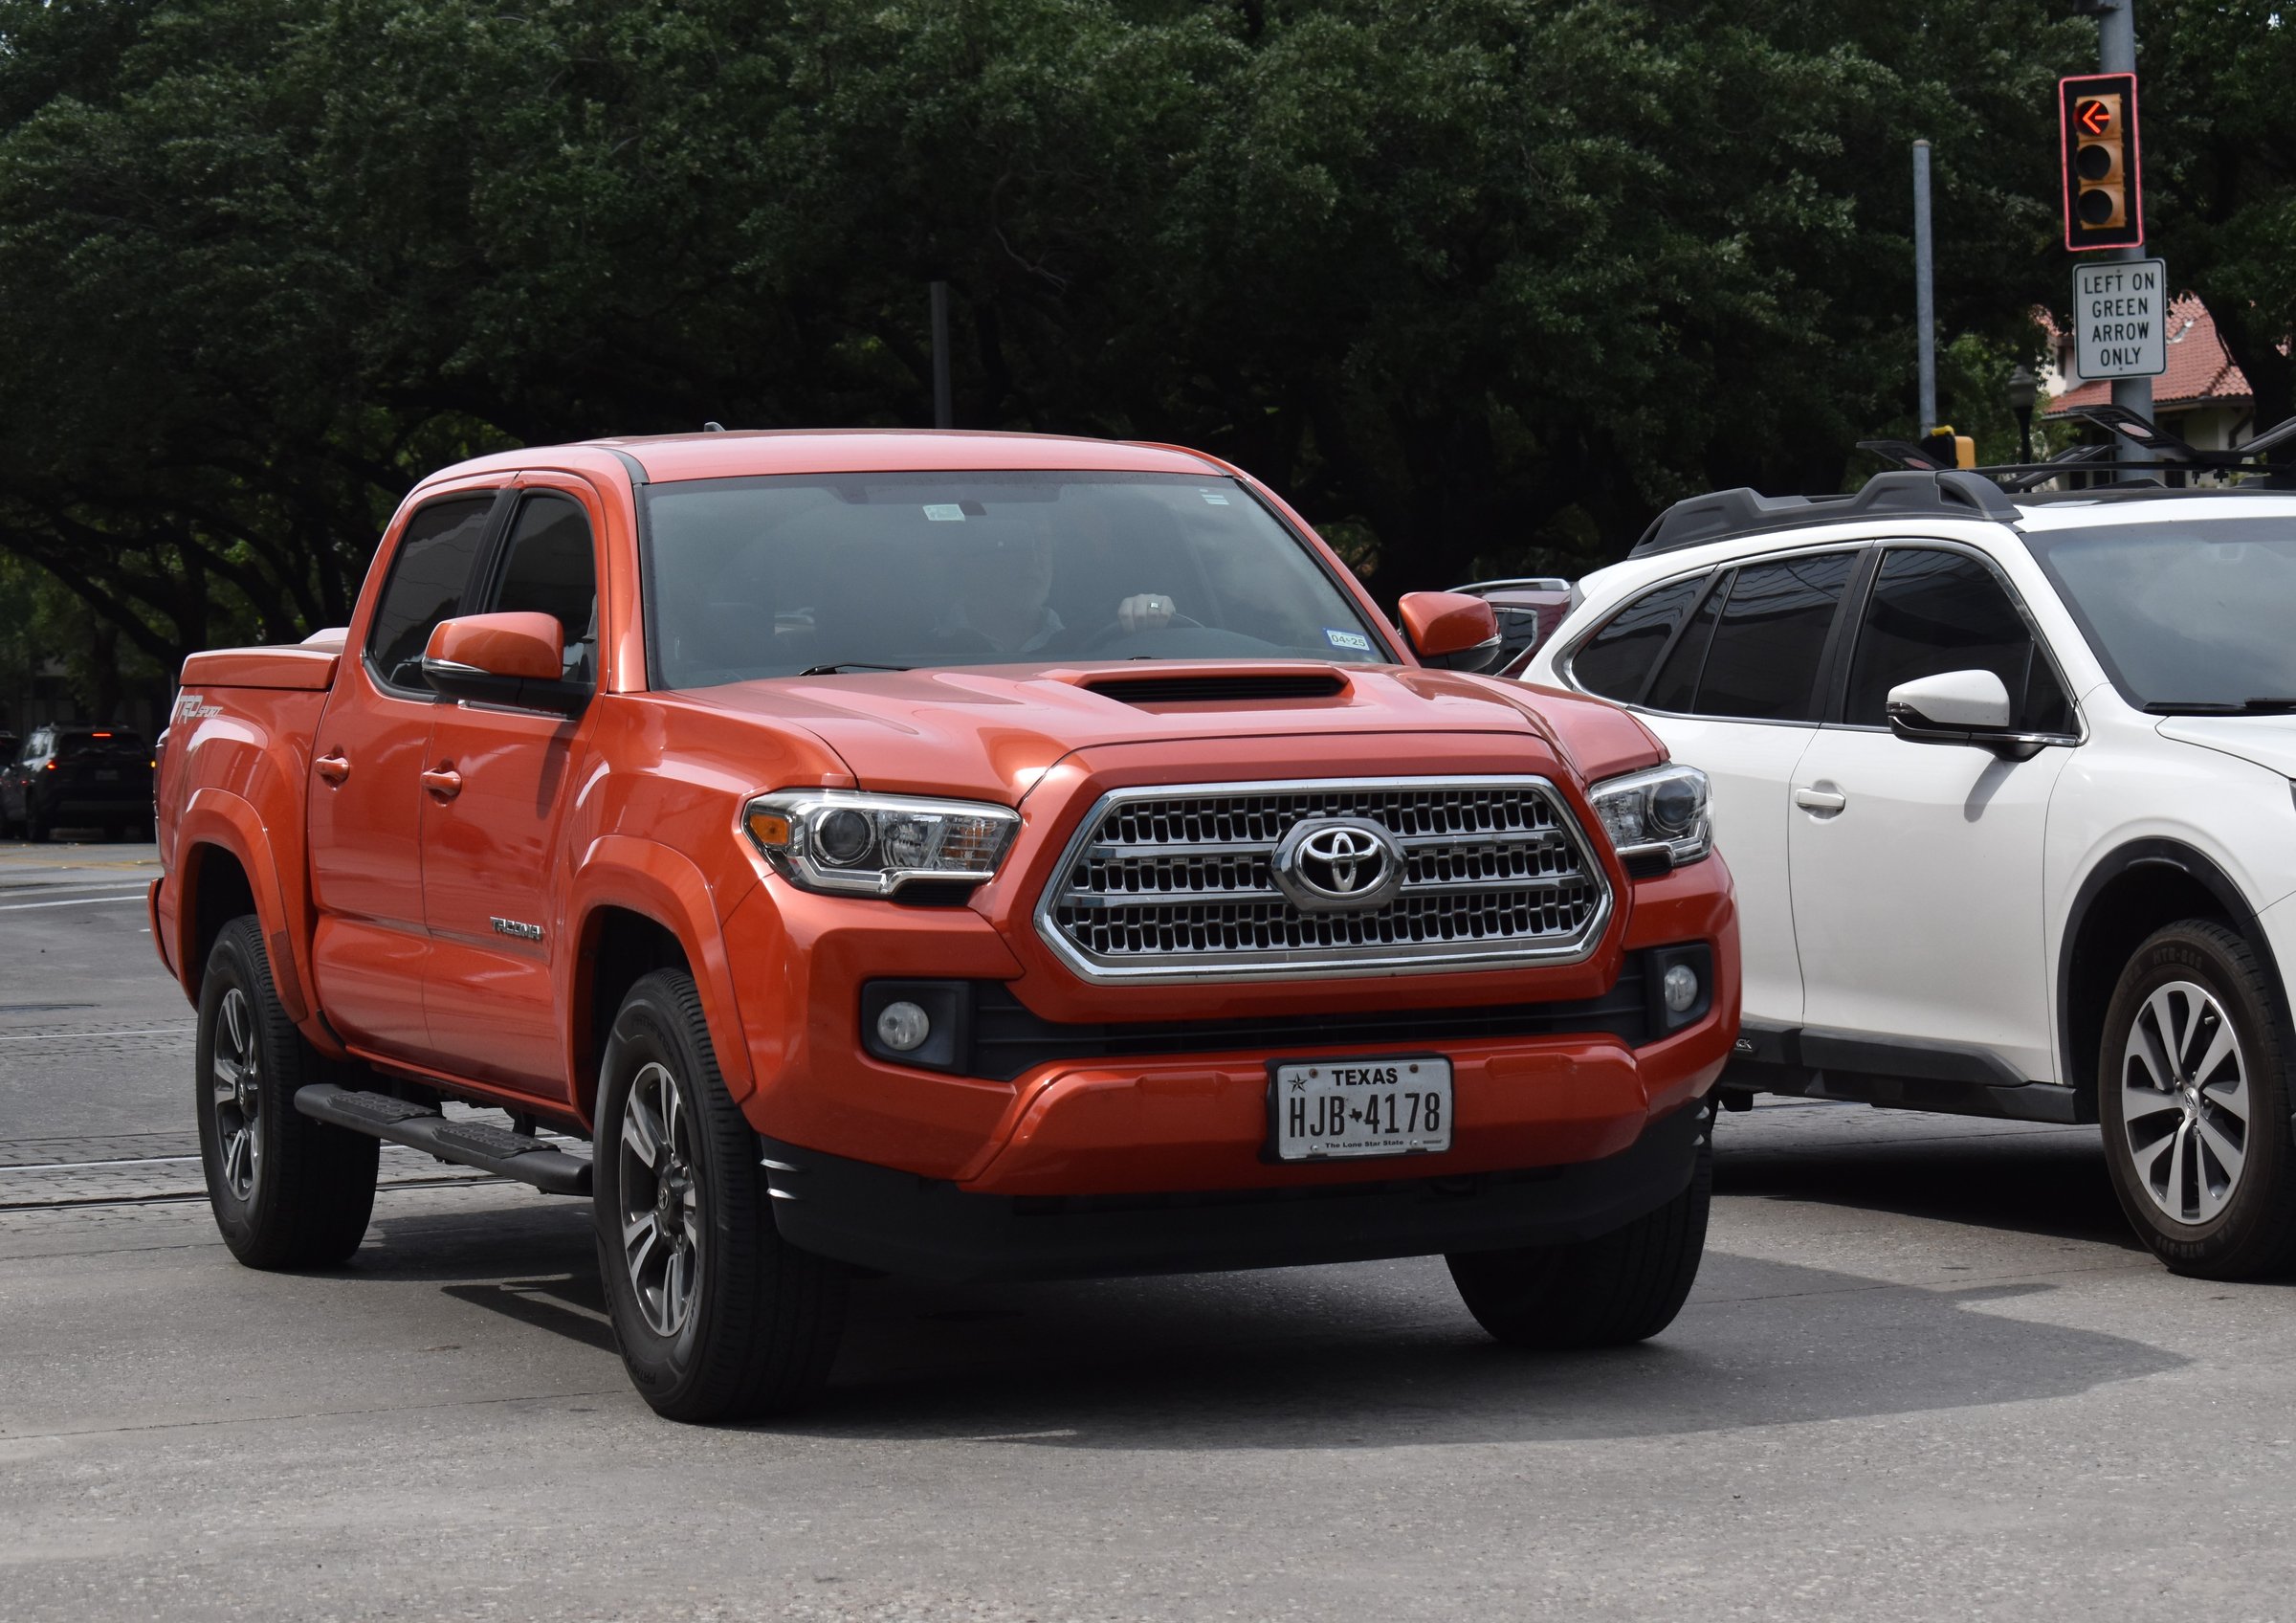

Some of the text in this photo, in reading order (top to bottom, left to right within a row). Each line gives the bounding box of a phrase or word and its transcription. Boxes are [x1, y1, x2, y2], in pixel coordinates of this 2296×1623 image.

[2085, 272, 2154, 295] LEFT ON
[2092, 298, 2148, 318] GREEN
[2092, 322, 2150, 343] ARROW
[2100, 346, 2141, 367] ONLY
[490, 916, 542, 941] TACOMA
[1331, 1067, 1398, 1086] TEXAS
